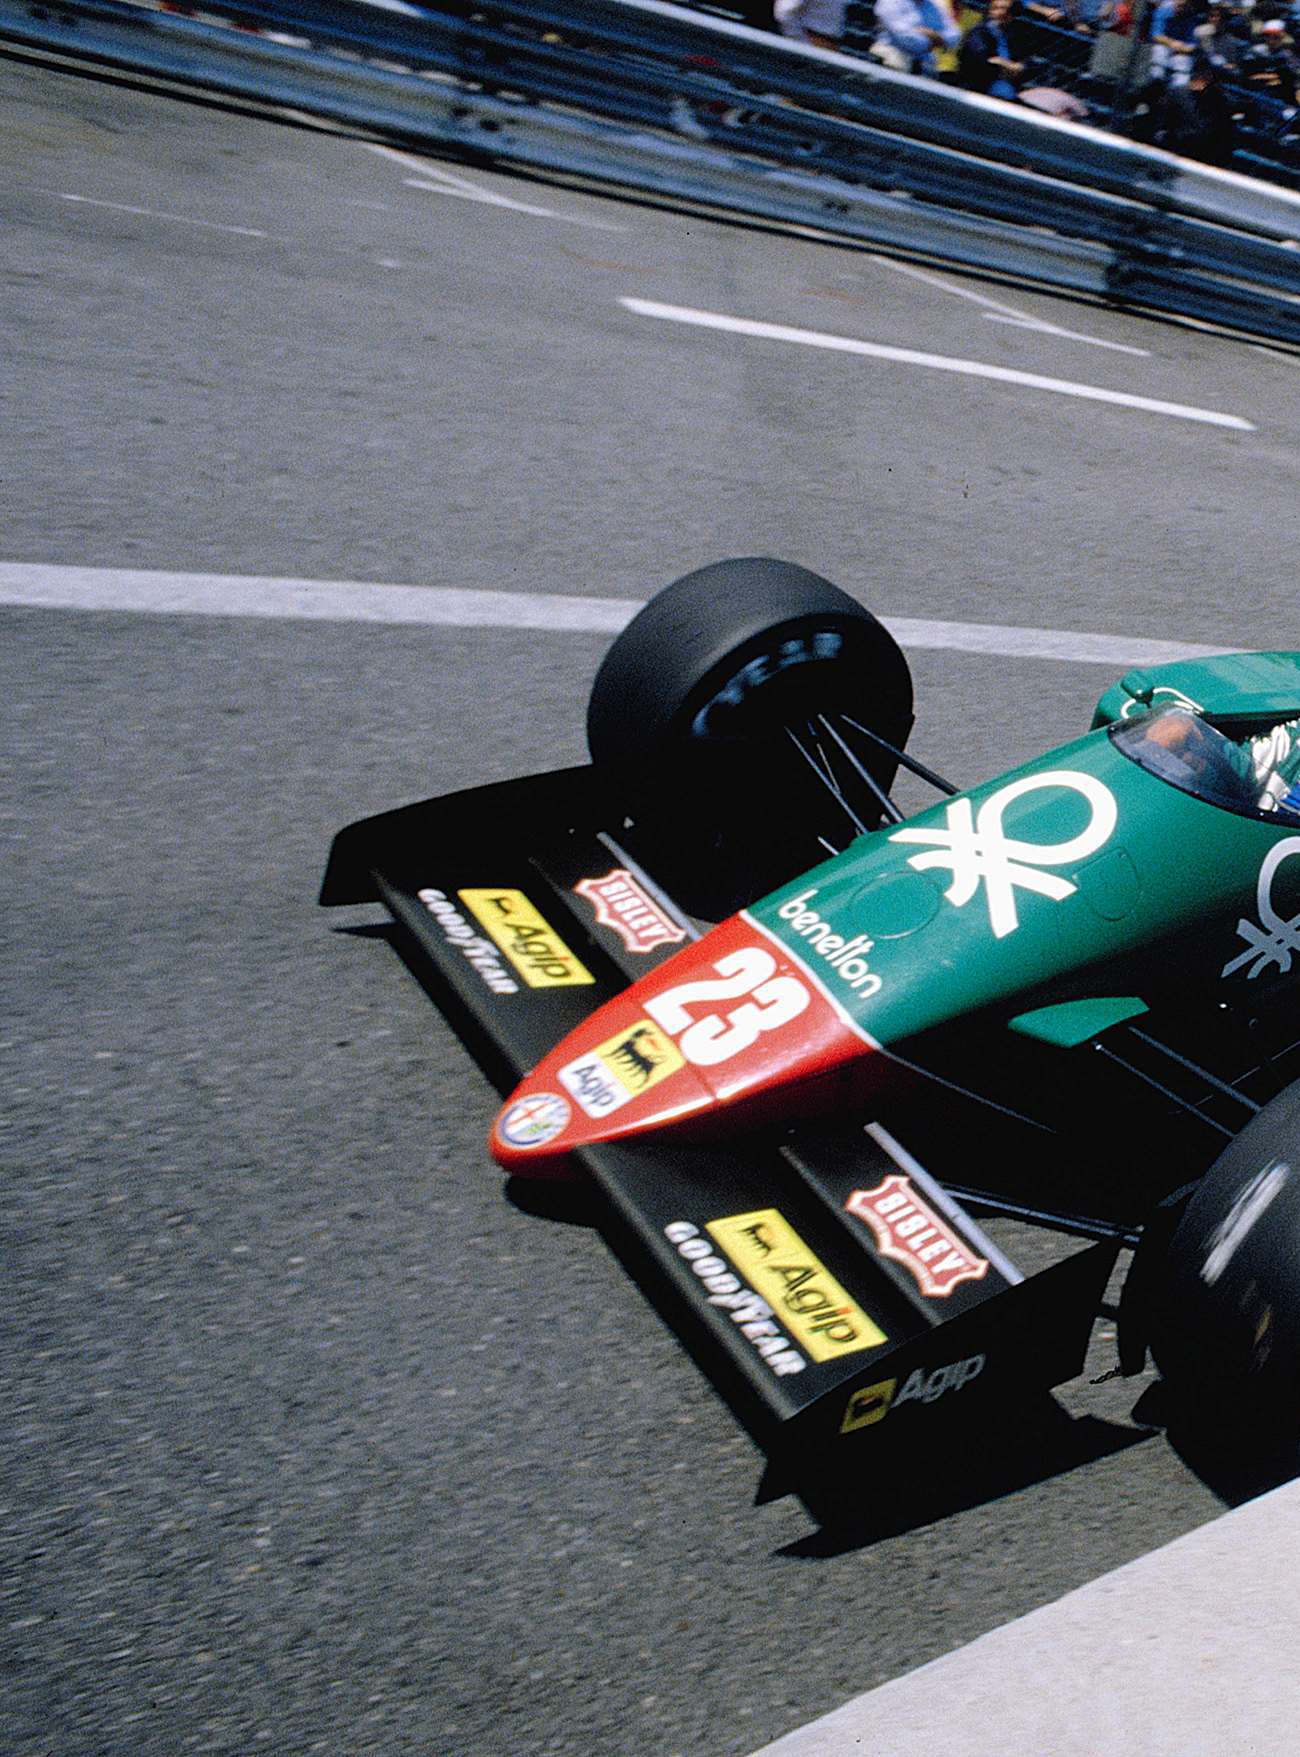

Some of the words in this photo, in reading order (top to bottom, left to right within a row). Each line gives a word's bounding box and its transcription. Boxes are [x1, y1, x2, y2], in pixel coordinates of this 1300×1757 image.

[417, 888, 519, 994] GOODYEAR
[598, 881, 668, 938] BISLEY
[778, 888, 882, 998] benetton
[505, 922, 571, 979] Agip
[642, 946, 811, 1067] 23
[571, 1064, 616, 1107] Agip
[873, 1192, 966, 1274] BISLEY
[664, 1220, 807, 1378] GOODYEAR
[768, 1264, 859, 1345] Agip
[891, 1353, 986, 1408] Agip
